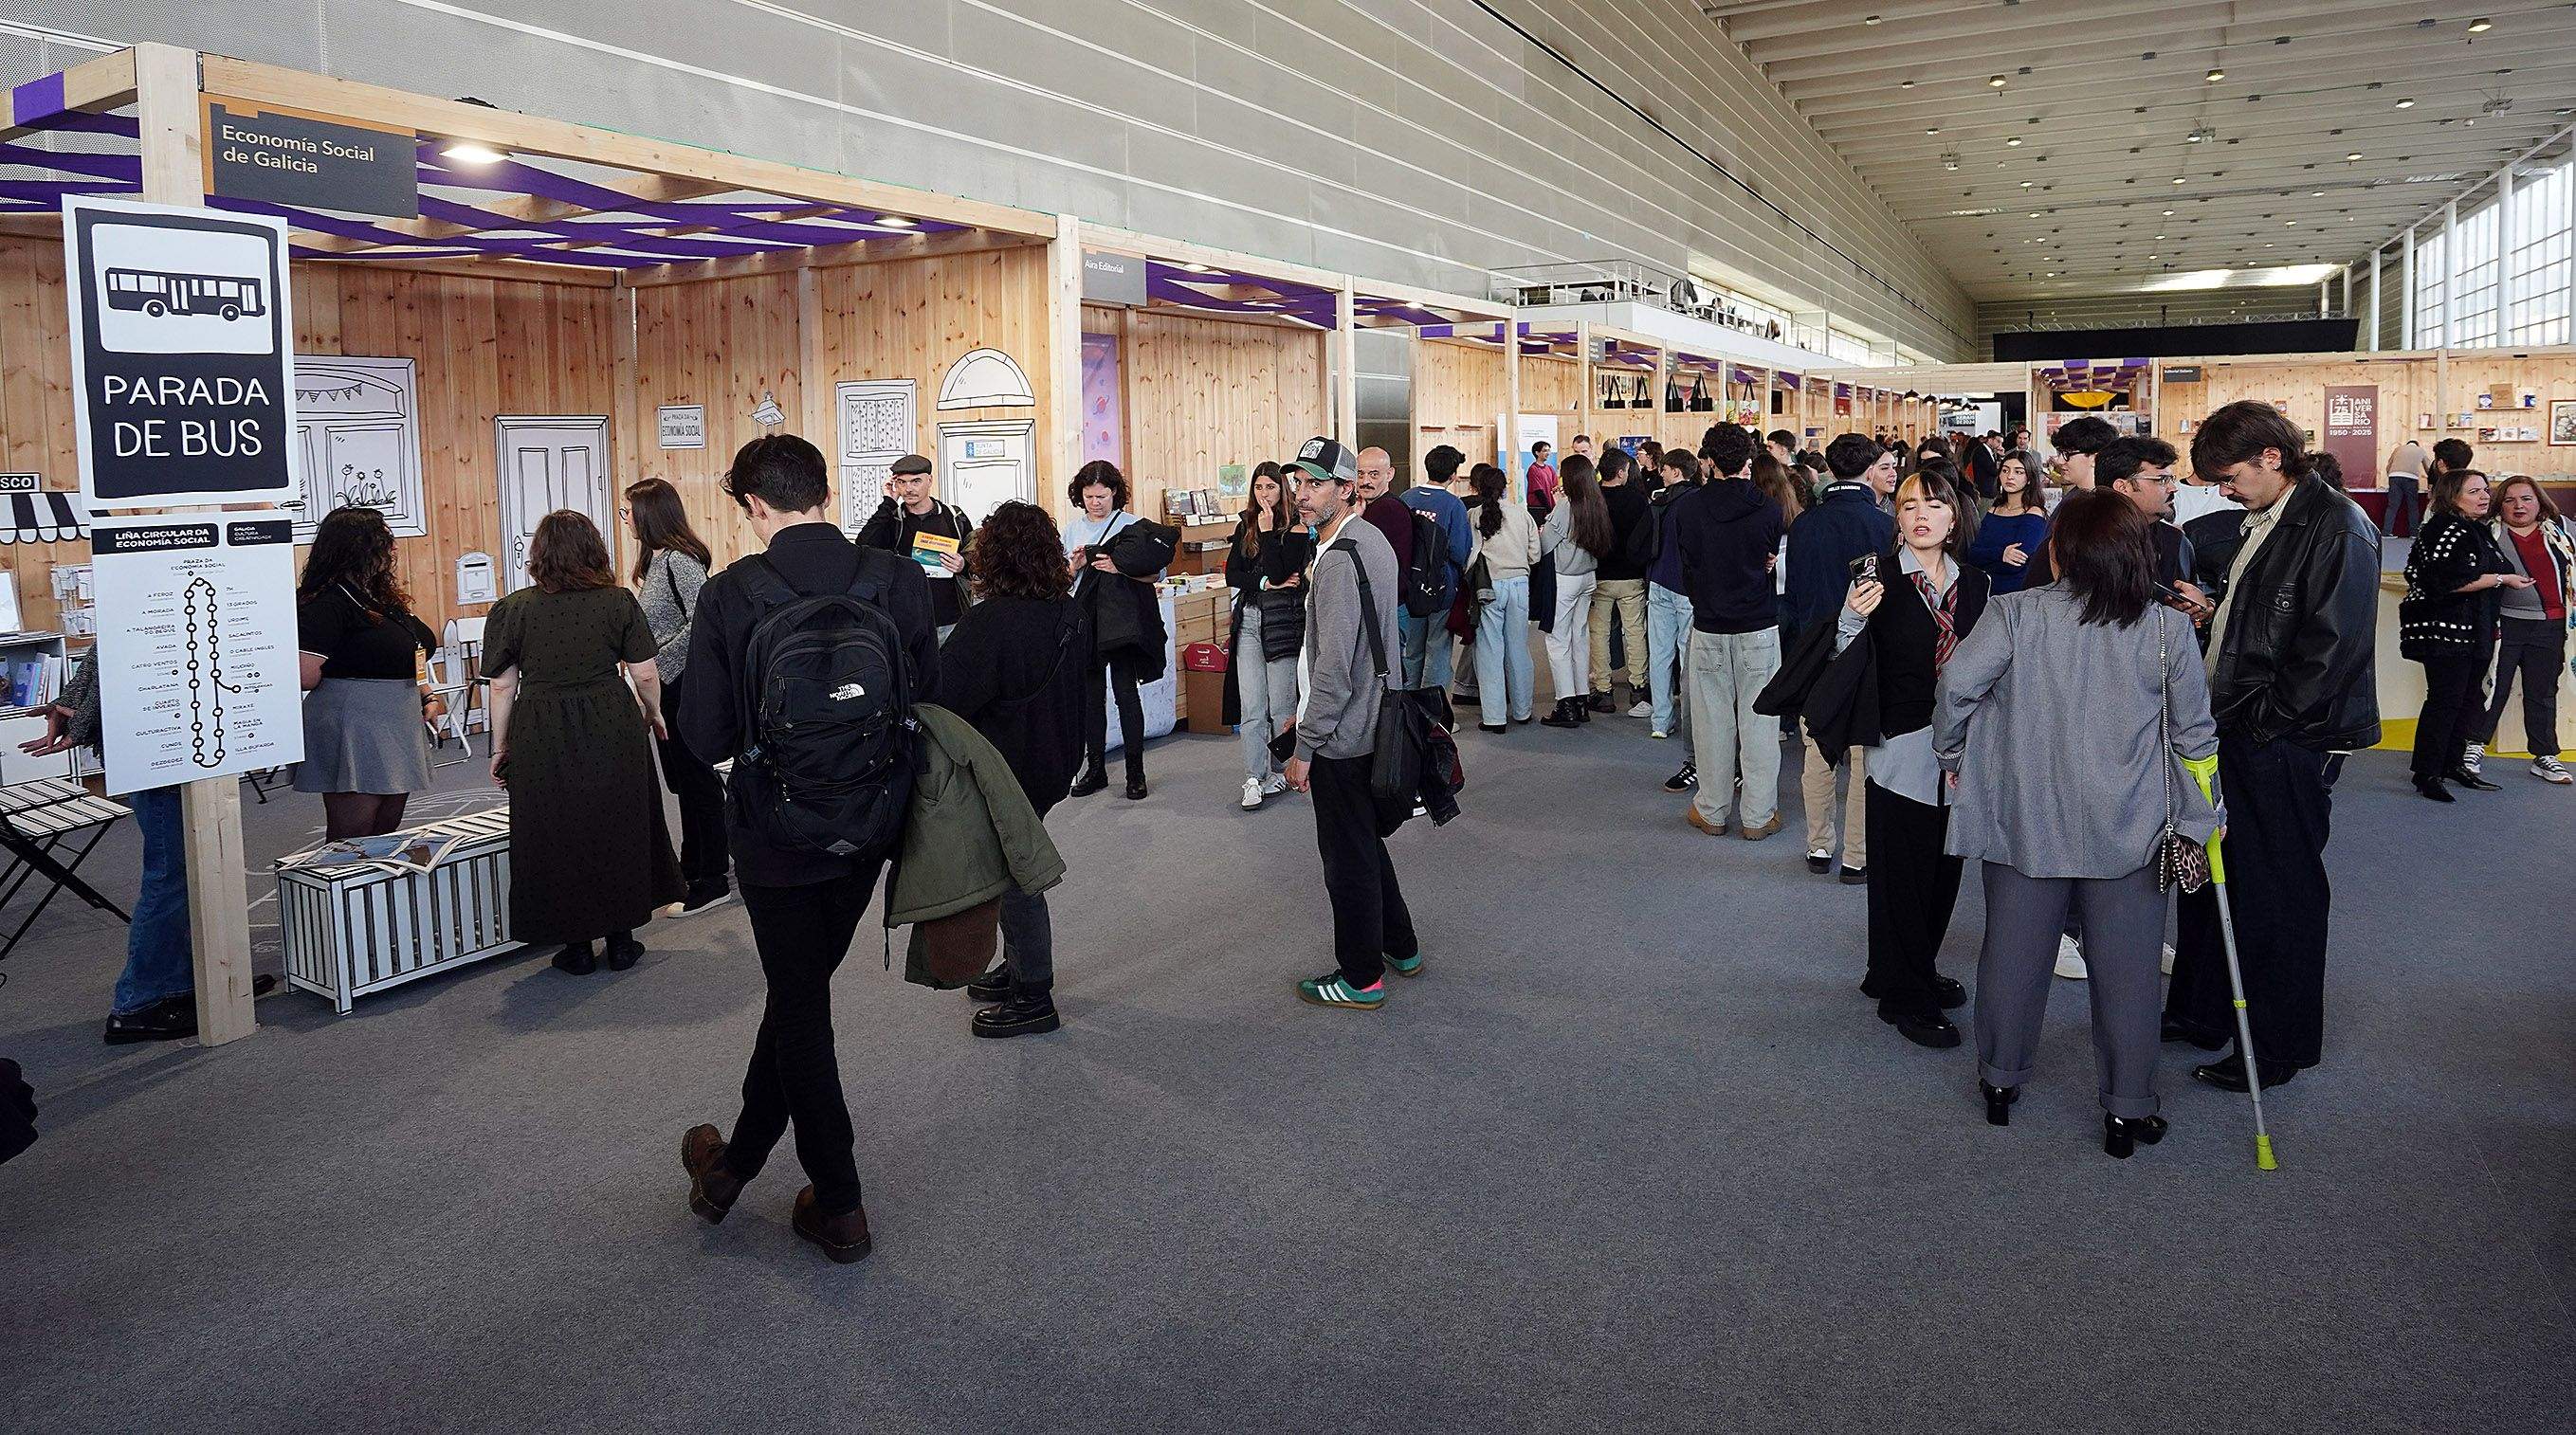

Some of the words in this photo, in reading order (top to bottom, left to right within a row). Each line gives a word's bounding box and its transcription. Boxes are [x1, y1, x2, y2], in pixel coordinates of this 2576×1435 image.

[222, 124, 318, 154] Economía
[322, 140, 375, 162] Social
[223, 147, 248, 164] de
[253, 151, 318, 173] Galicia
[1085, 260, 1098, 269] Aira
[1099, 262, 1124, 273] Editorial
[103, 375, 270, 406] PARADA
[115, 420, 171, 457] DE
[181, 419, 263, 456] BUS
[0, 477, 32, 488] SCO
[116, 530, 140, 541] LIÑA
[142, 529, 194, 539] CIRCULAR
[195, 528, 210, 536] DA
[116, 537, 172, 548] ECONOMÍA
[174, 536, 210, 546] SOCIAL
[829, 689, 851, 699] NORTH
